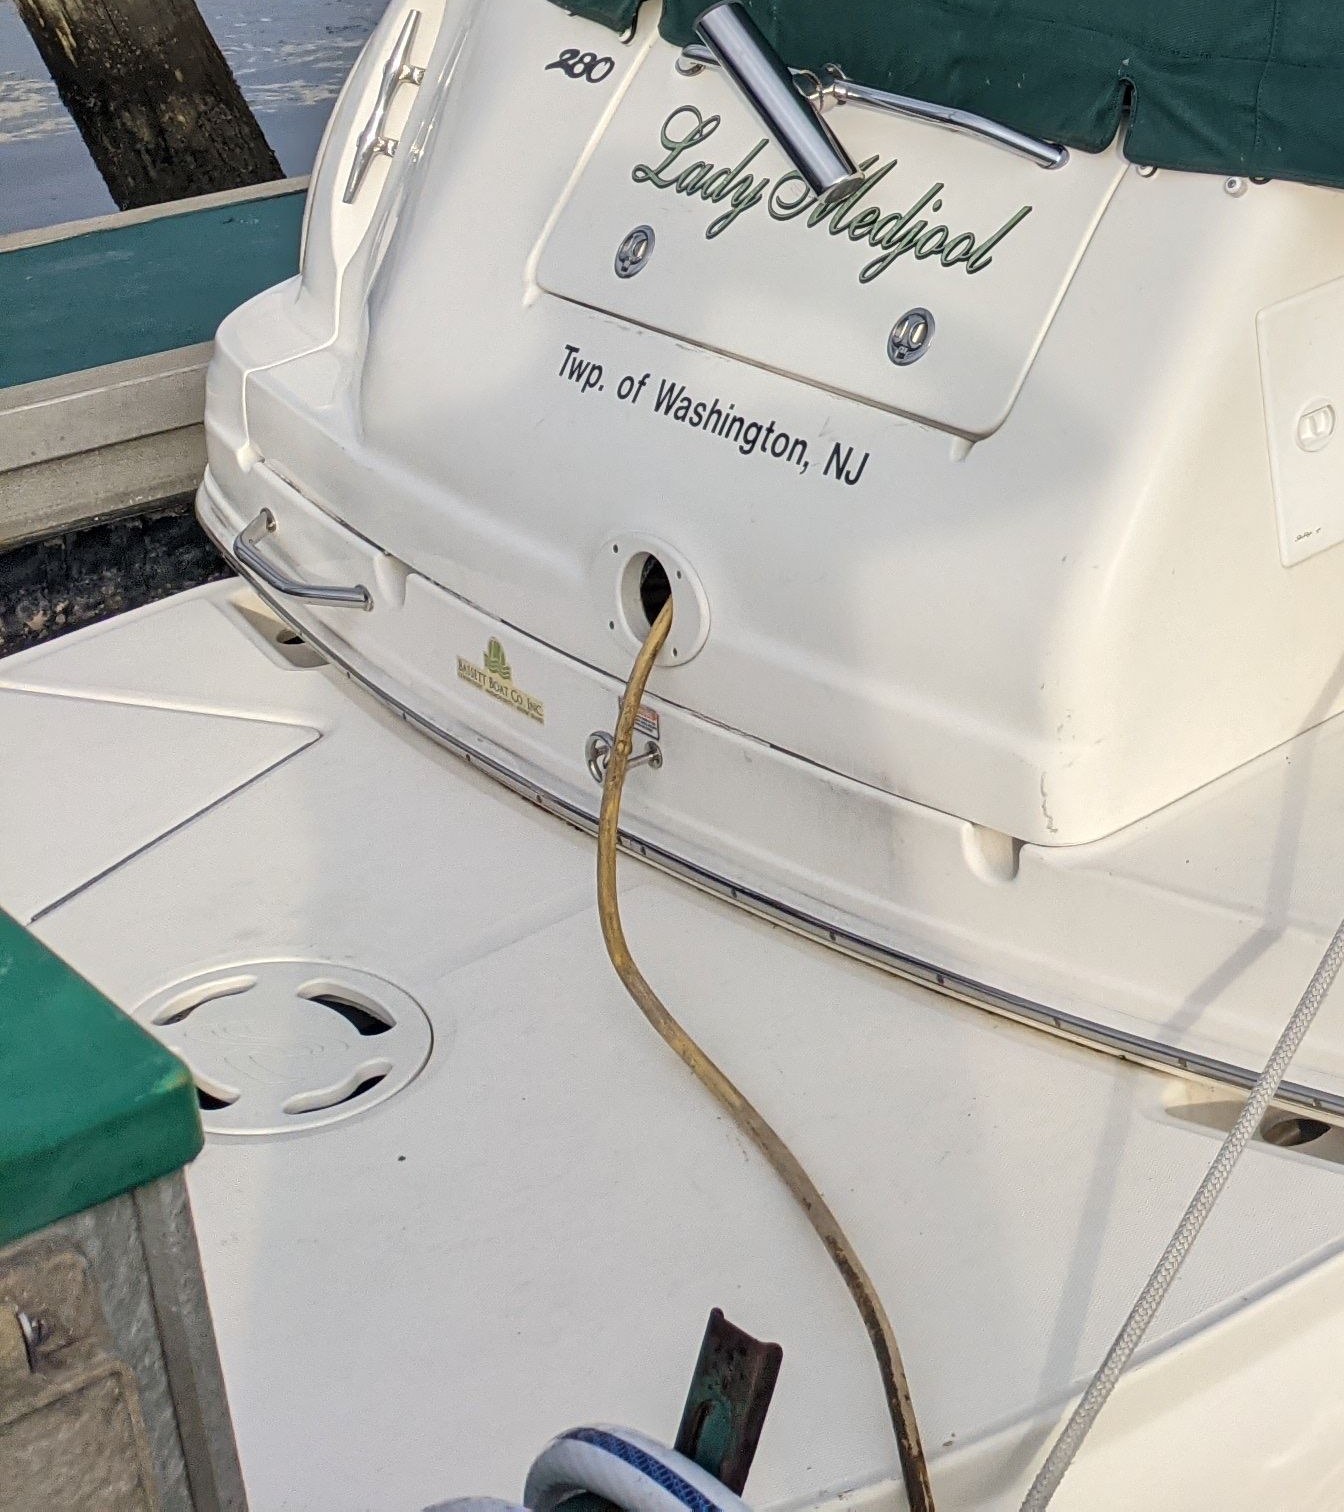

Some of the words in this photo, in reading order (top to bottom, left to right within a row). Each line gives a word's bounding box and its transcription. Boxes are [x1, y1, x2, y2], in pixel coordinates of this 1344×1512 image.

[544, 48, 616, 83] 280
[632, 105, 770, 240] Lady
[768, 154, 1032, 284] Medjool
[558, 344, 604, 393] Twp.
[616, 373, 651, 403] of
[654, 378, 810, 476] Washington,
[822, 442, 870, 486] NJ
